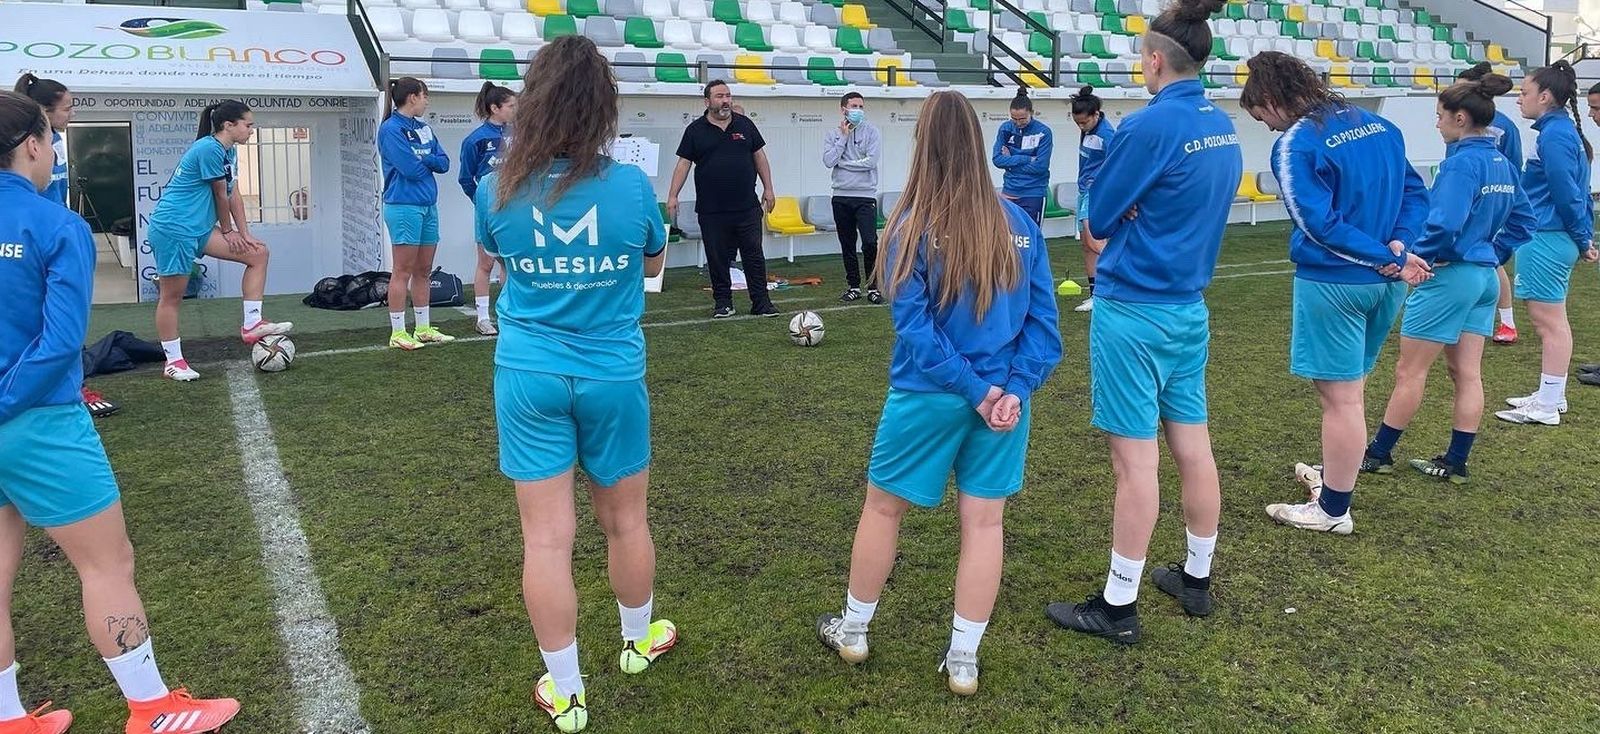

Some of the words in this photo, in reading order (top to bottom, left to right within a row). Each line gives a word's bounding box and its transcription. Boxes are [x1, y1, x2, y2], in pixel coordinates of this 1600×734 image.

[79, 68, 133, 76] Dehesa
[104, 98, 176, 108] OPORTUNIDAD
[240, 97, 302, 108] VOLUNTAD
[136, 111, 198, 121] CONVIVIR
[149, 124, 198, 133] ADELANTE
[137, 159, 158, 175] EL
[510, 254, 630, 274] IGLESIAS
[531, 281, 564, 289] muebles
[565, 282, 573, 290] &
[573, 279, 618, 291] decoración
